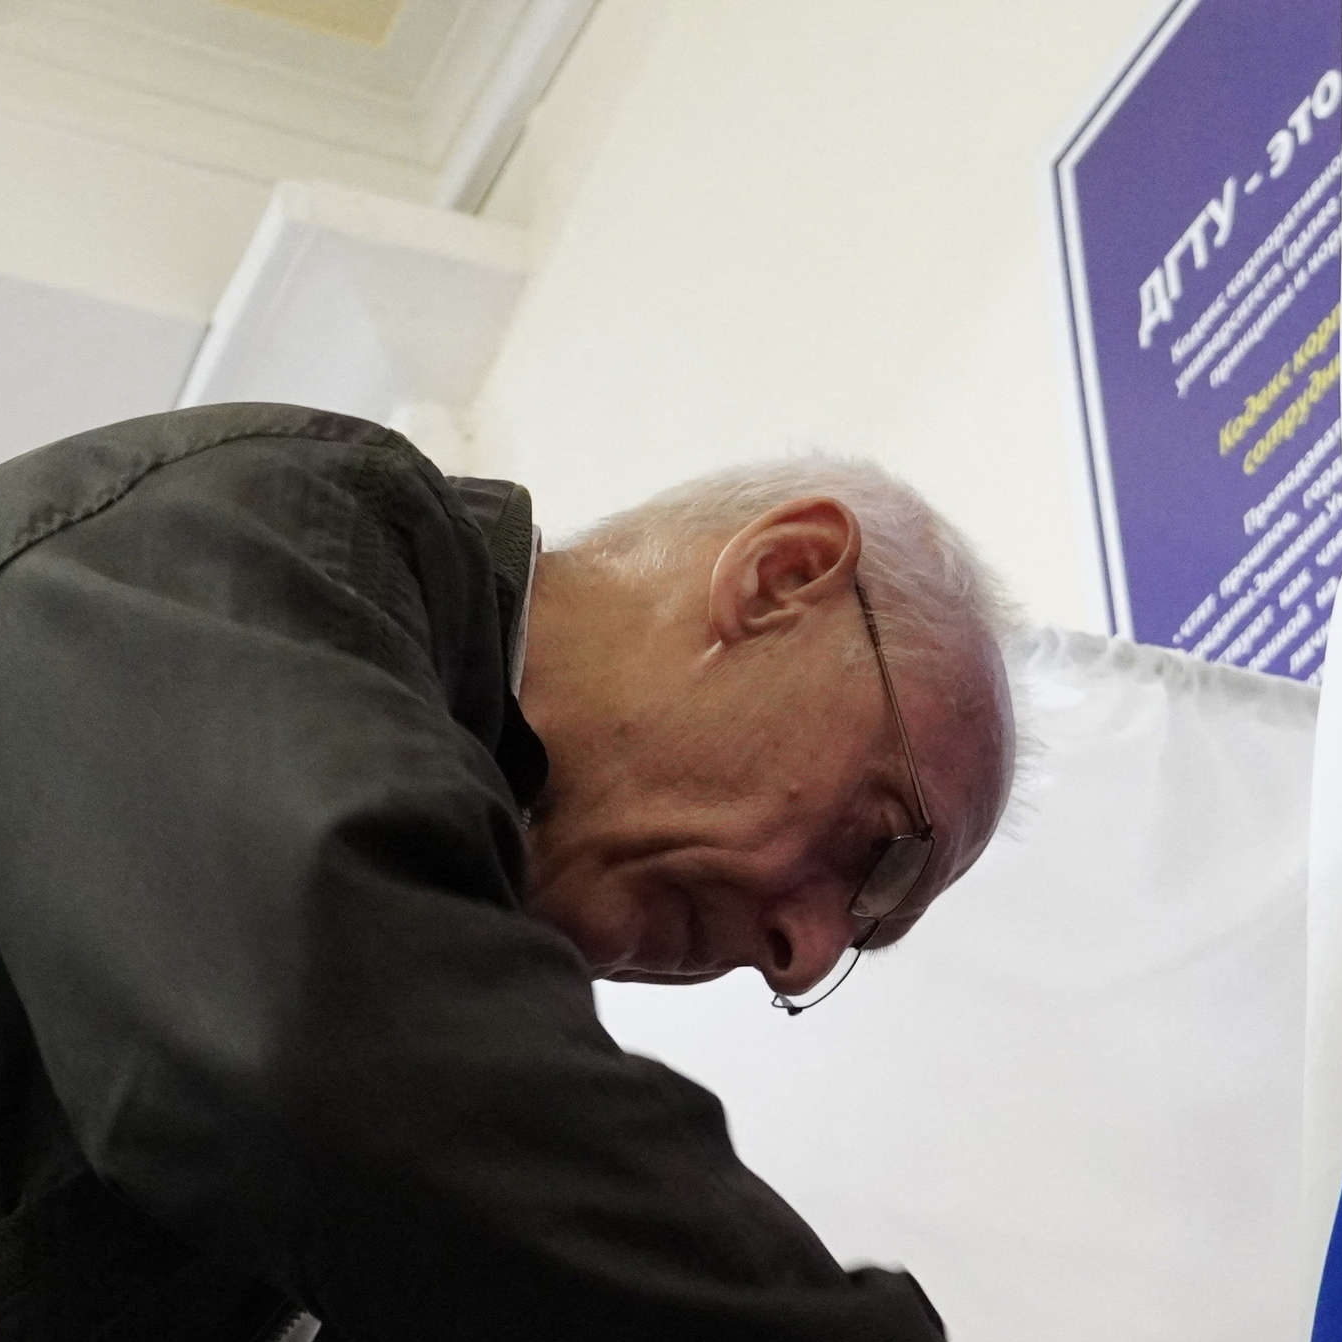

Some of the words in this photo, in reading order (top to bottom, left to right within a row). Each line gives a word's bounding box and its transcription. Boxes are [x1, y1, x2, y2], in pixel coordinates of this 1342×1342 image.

[1138, 176, 1237, 349] ДГТУ
[1226, 151, 1342, 299] корпоративно
[1307, 221, 1342, 273] нор
[1219, 361, 1292, 455] Кодекс
